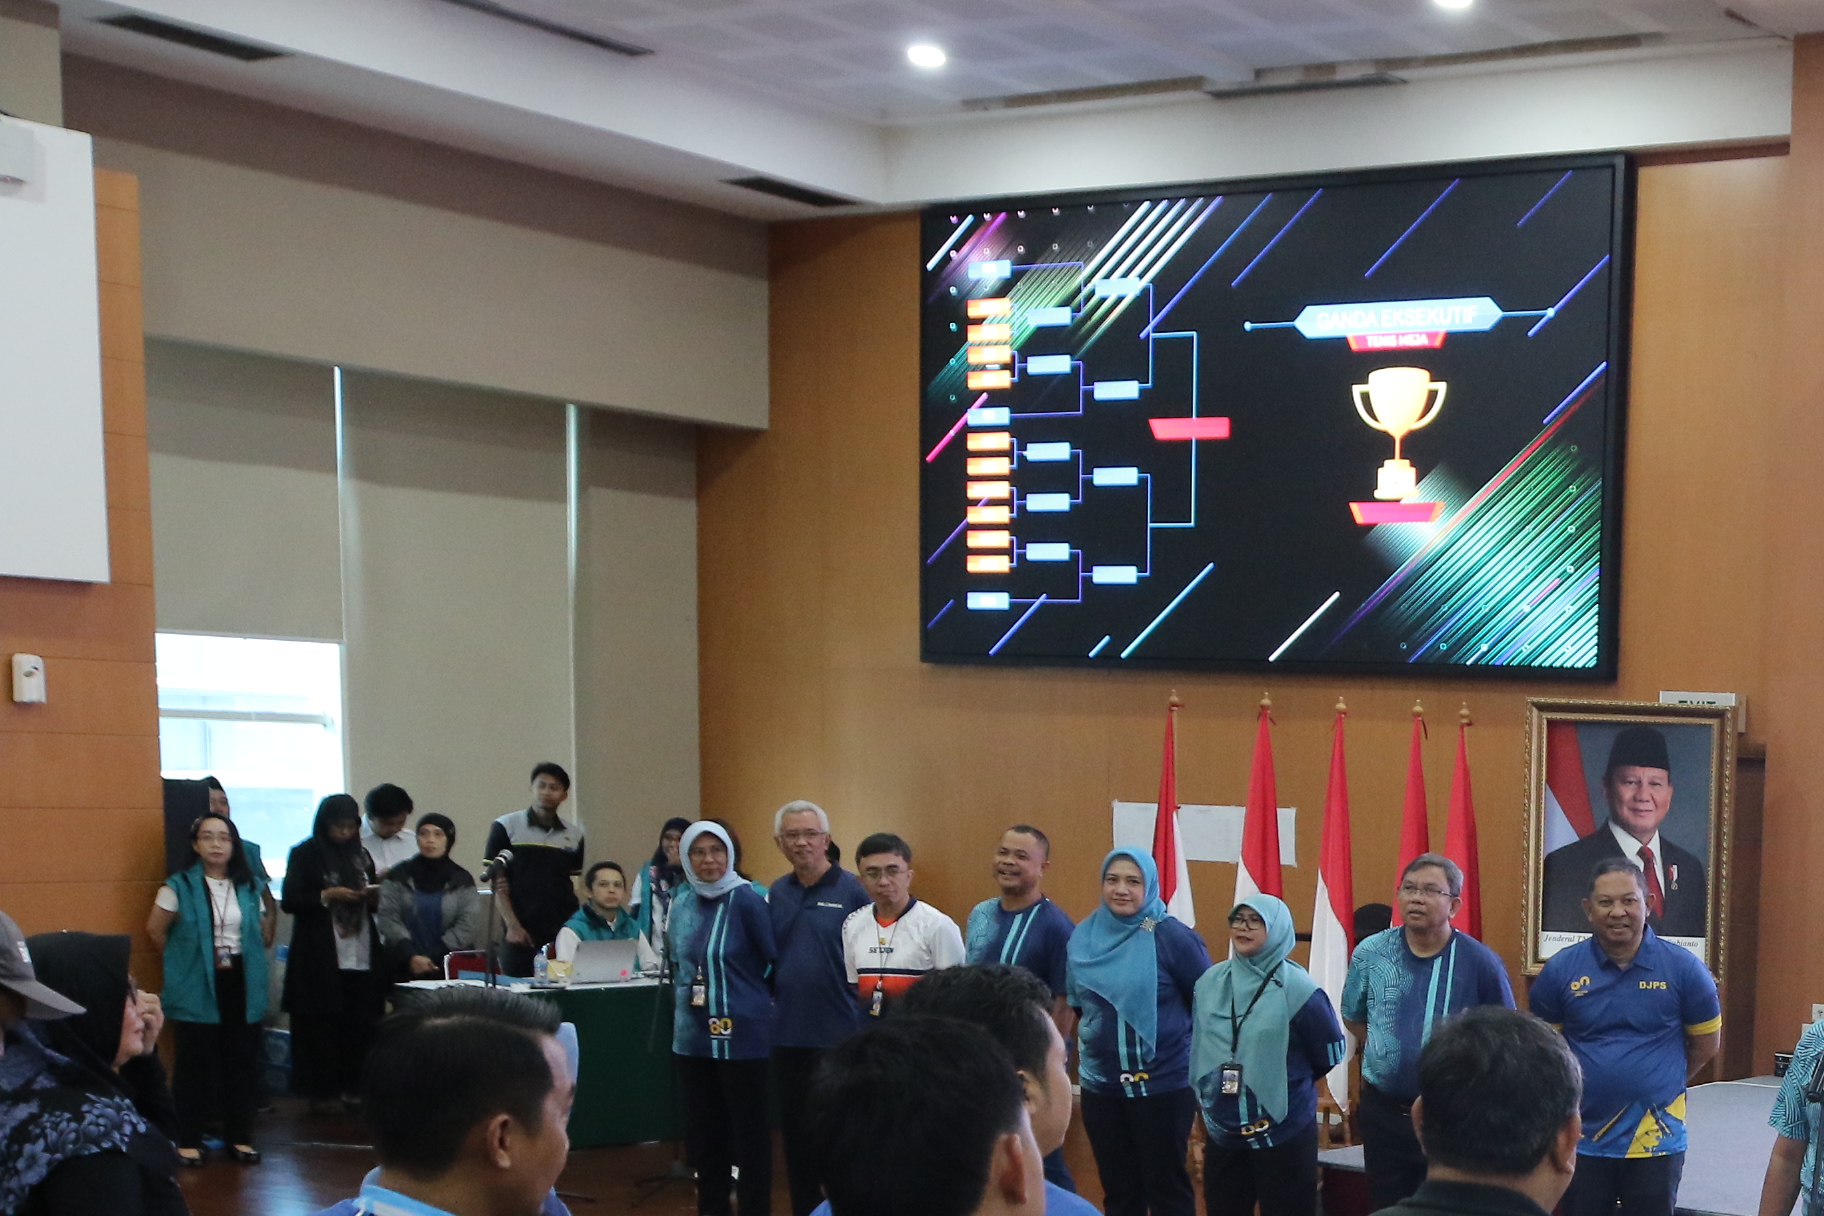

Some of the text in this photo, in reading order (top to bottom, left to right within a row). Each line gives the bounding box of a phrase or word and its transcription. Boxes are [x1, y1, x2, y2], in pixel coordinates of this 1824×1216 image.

[1316, 304, 1479, 330] GANDA EKSEKUTIF
[1638, 980, 1668, 990] DJPS
